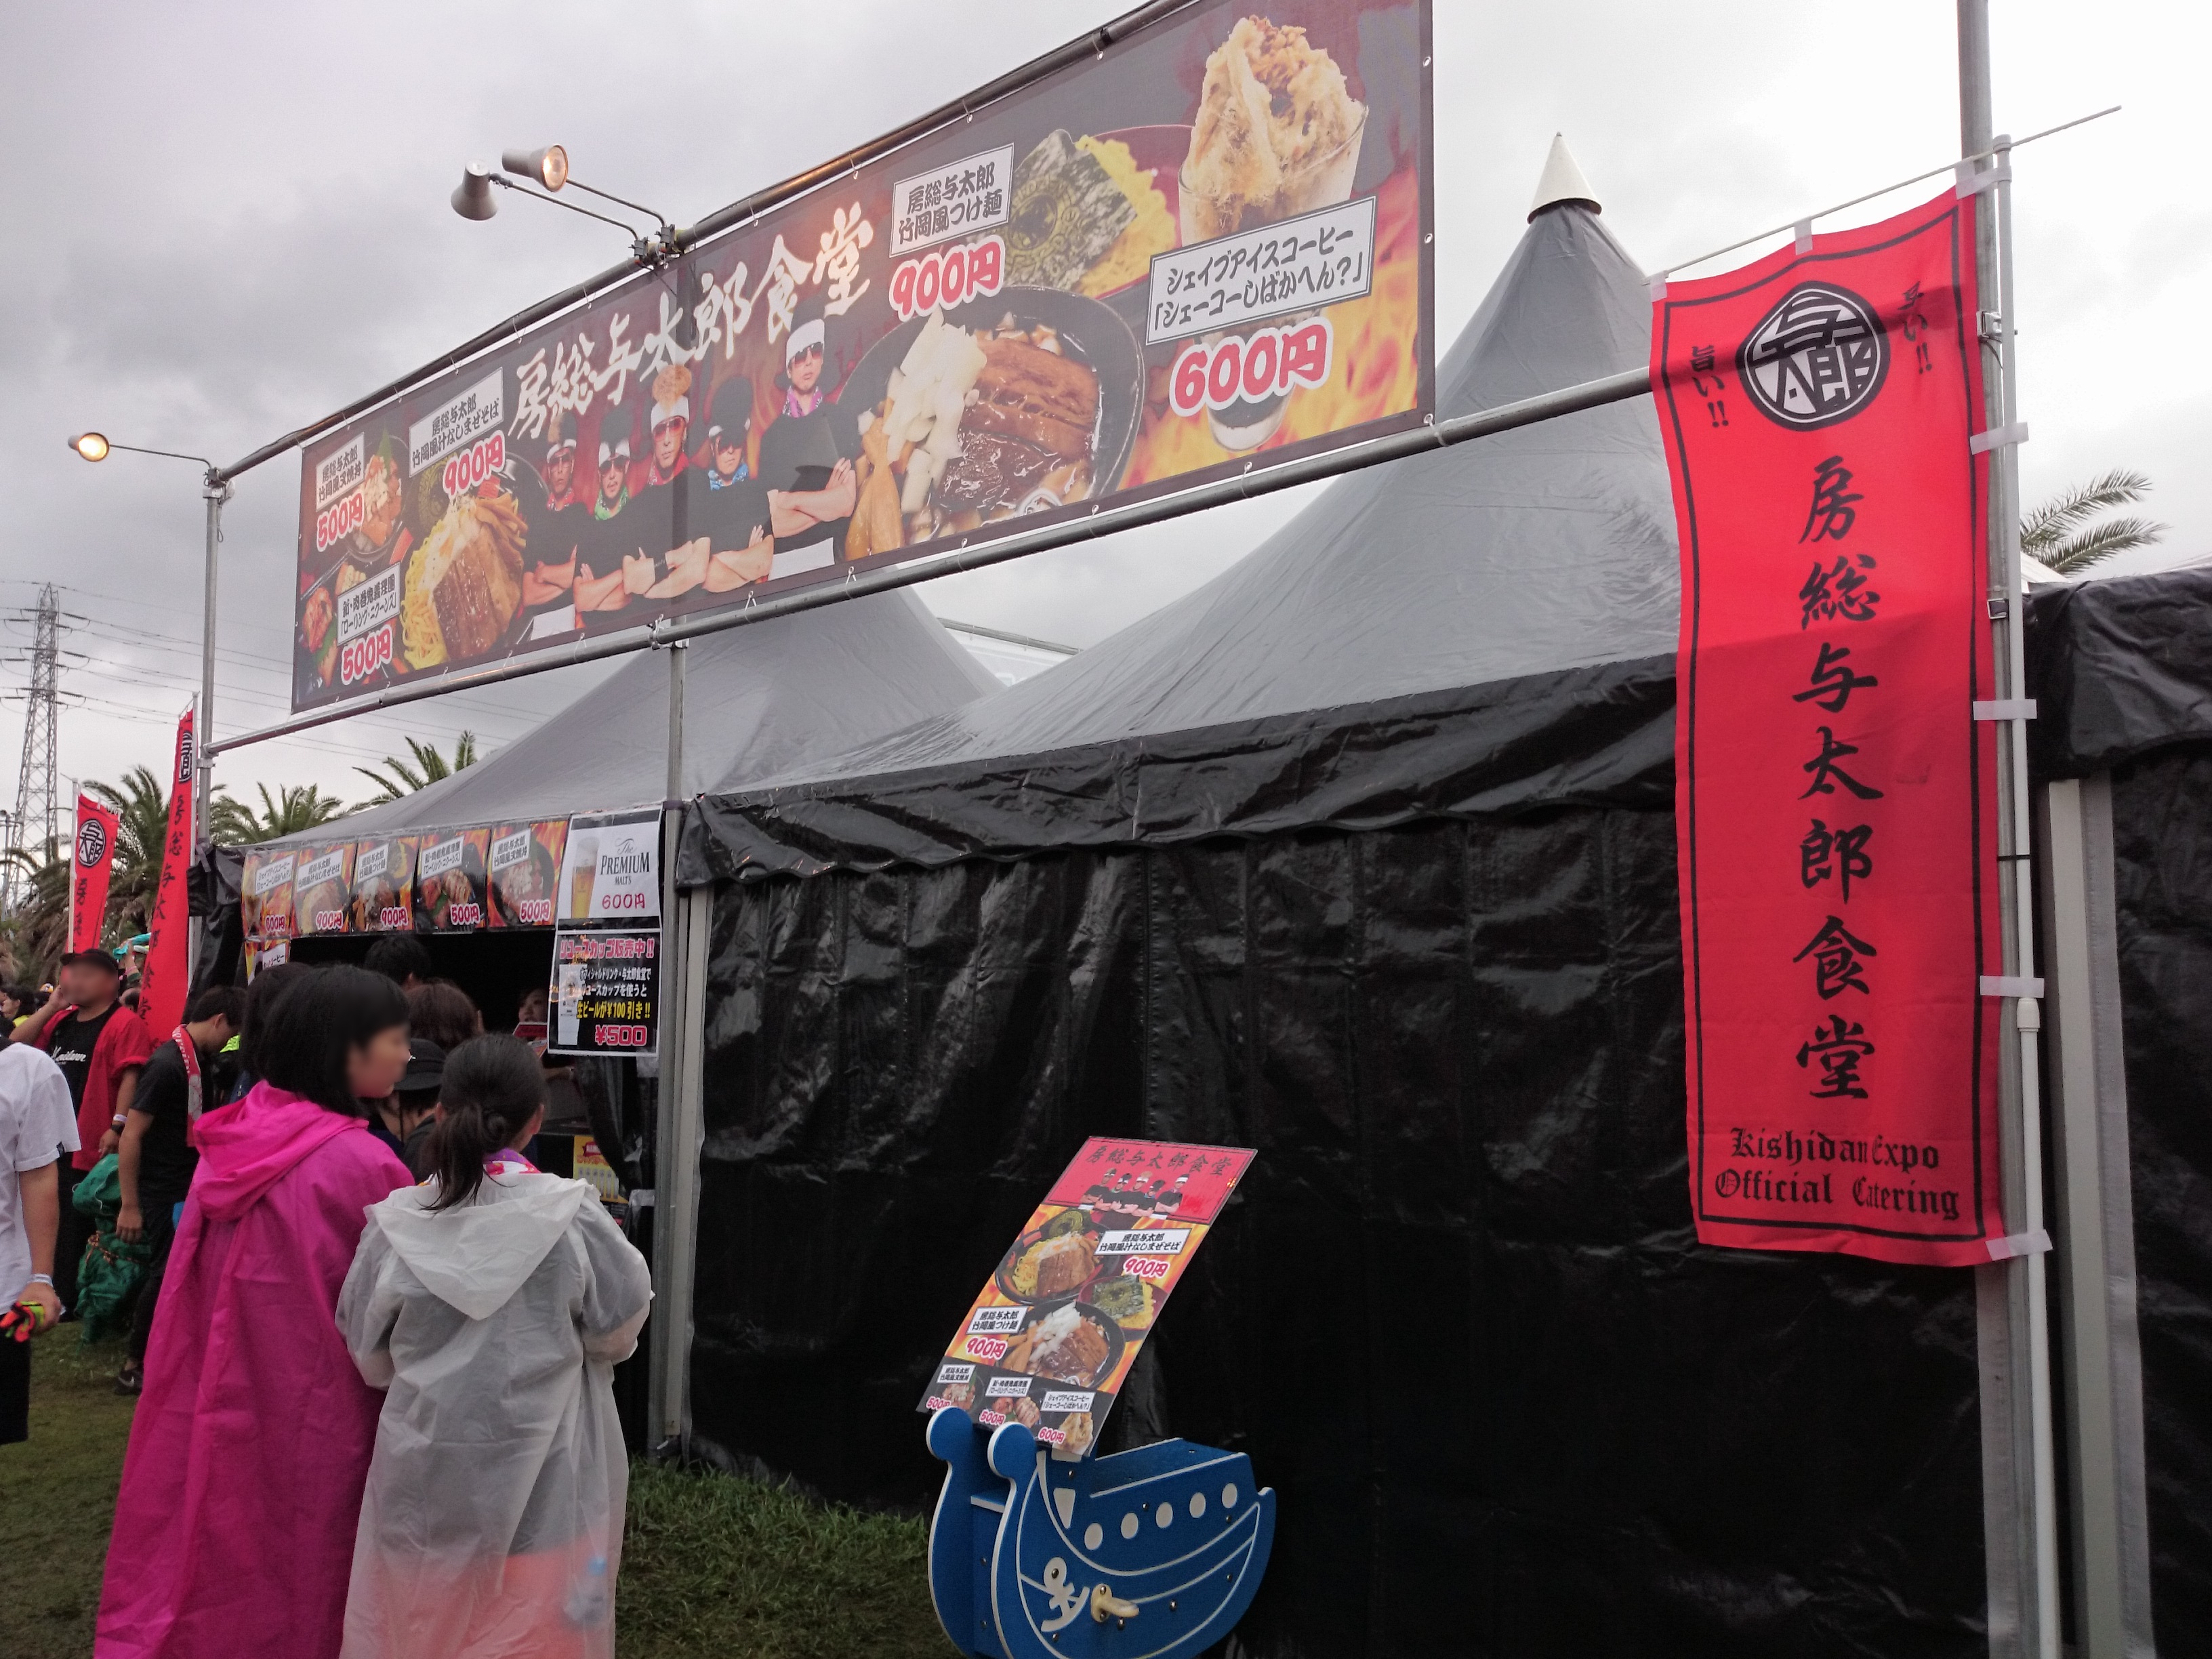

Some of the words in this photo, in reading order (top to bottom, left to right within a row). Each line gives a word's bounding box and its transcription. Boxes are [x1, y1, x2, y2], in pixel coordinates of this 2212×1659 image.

[907, 160, 996, 216] 房総与太郎
[897, 188, 1003, 245] 竹岡風つけ麺
[892, 241, 1001, 314] 900円
[1167, 226, 1354, 295] シェイブアイスコーヒー
[507, 201, 874, 441] 房総与太郎食堂
[1174, 323, 1328, 409] 600円
[412, 397, 499, 468] 竹岡風汁なしまぜそば
[432, 392, 477, 438] 房総与太郎
[322, 444, 359, 483] 房総与太郎
[444, 434, 504, 497] 900円
[316, 491, 364, 550] 500円
[343, 626, 392, 683] 500円
[1793, 455, 1885, 1101] 房総与太郎食堂
[600, 852, 650, 875] PREMIUM
[615, 838, 635, 855] The
[381, 908, 407, 926] 900円
[451, 903, 480, 924] 500円
[520, 900, 550, 922] 500円
[602, 893, 645, 909] 600円
[266, 915, 285, 933] 600円
[316, 911, 343, 929] 900円
[594, 1024, 648, 1046] ¥500
[1086, 1145, 1233, 1176] 房総与太郎食堂
[1715, 1168, 1835, 1204] Official
[1852, 1176, 1960, 1221] Catering
[1124, 1257, 1169, 1277] 900円
[966, 1337, 1007, 1358] 900円
[979, 1410, 1005, 1425] 500円
[1038, 1427, 1065, 1443] 600円
